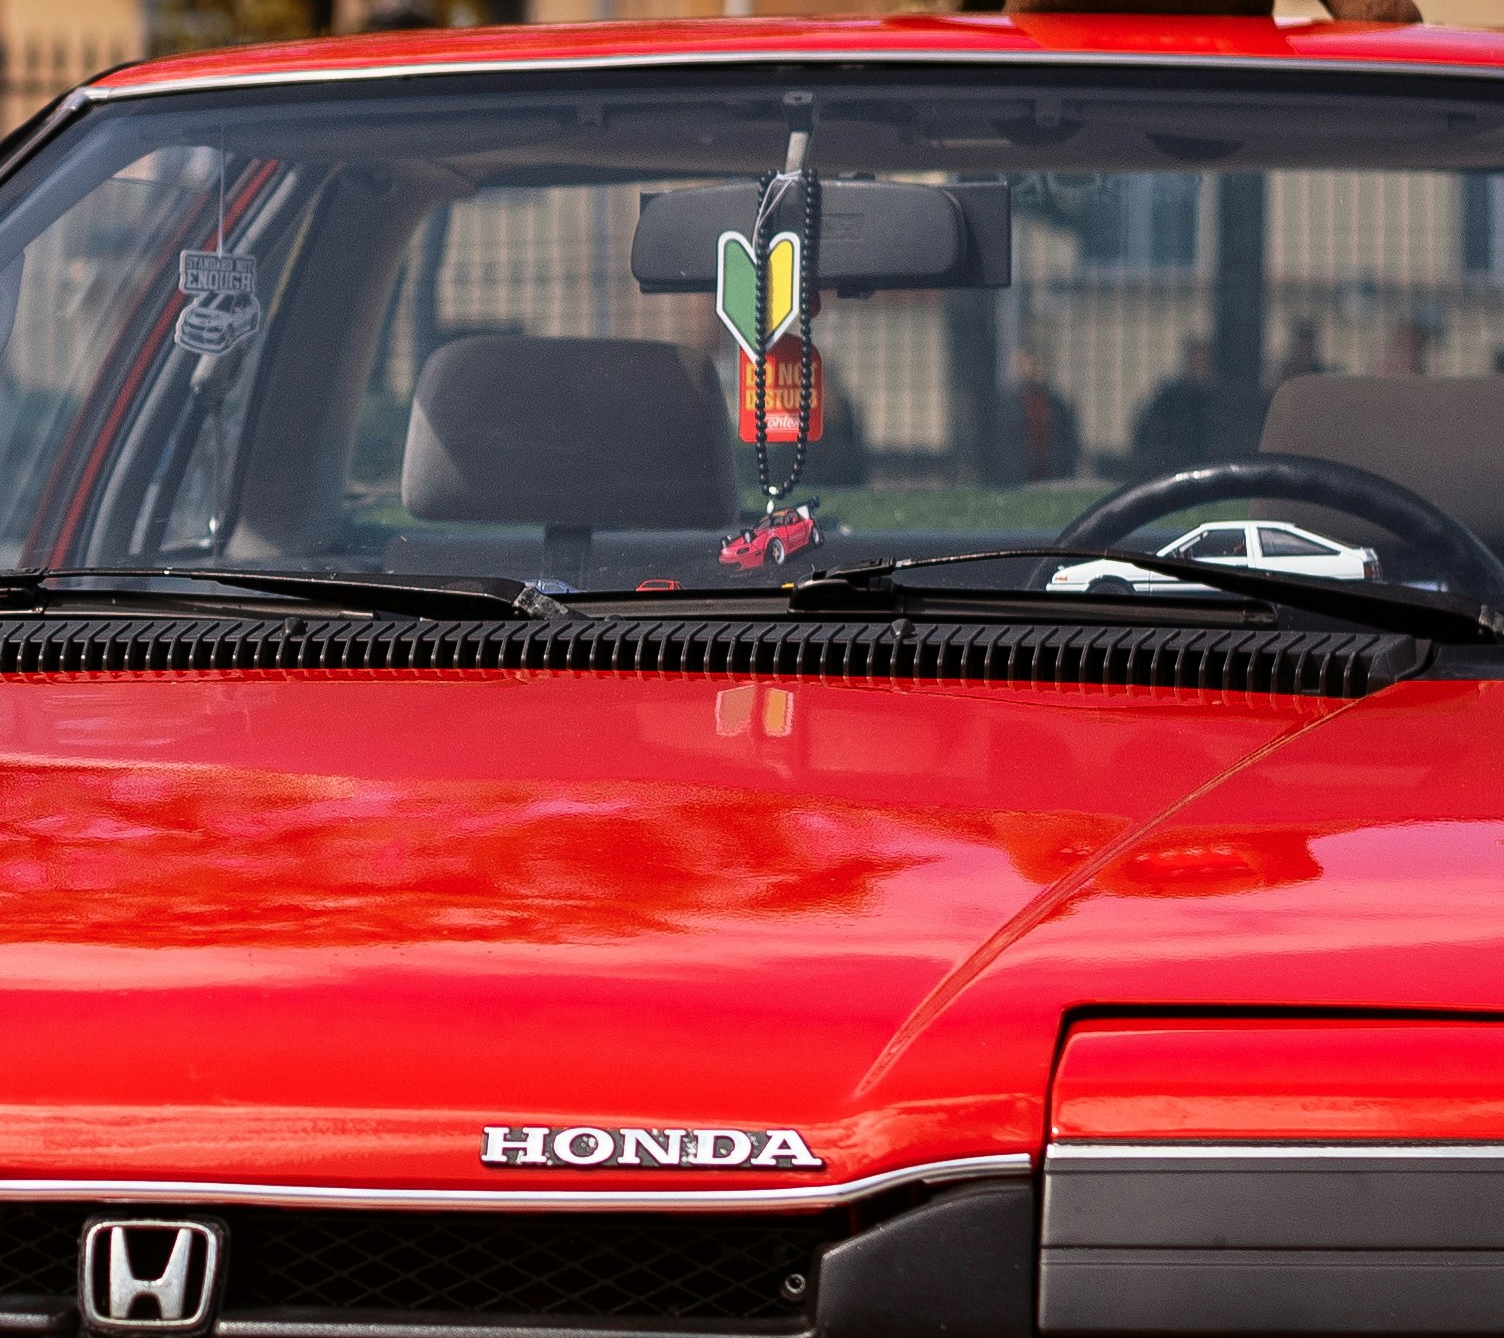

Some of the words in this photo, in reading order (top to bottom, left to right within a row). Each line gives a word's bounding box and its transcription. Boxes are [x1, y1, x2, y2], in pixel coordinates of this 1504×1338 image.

[186, 257, 233, 271] STANDARD
[185, 269, 252, 292] ENOUGH
[745, 389, 818, 411] DSTUB
[480, 1126, 823, 1166] HONDA
[109, 1226, 192, 1319] H
